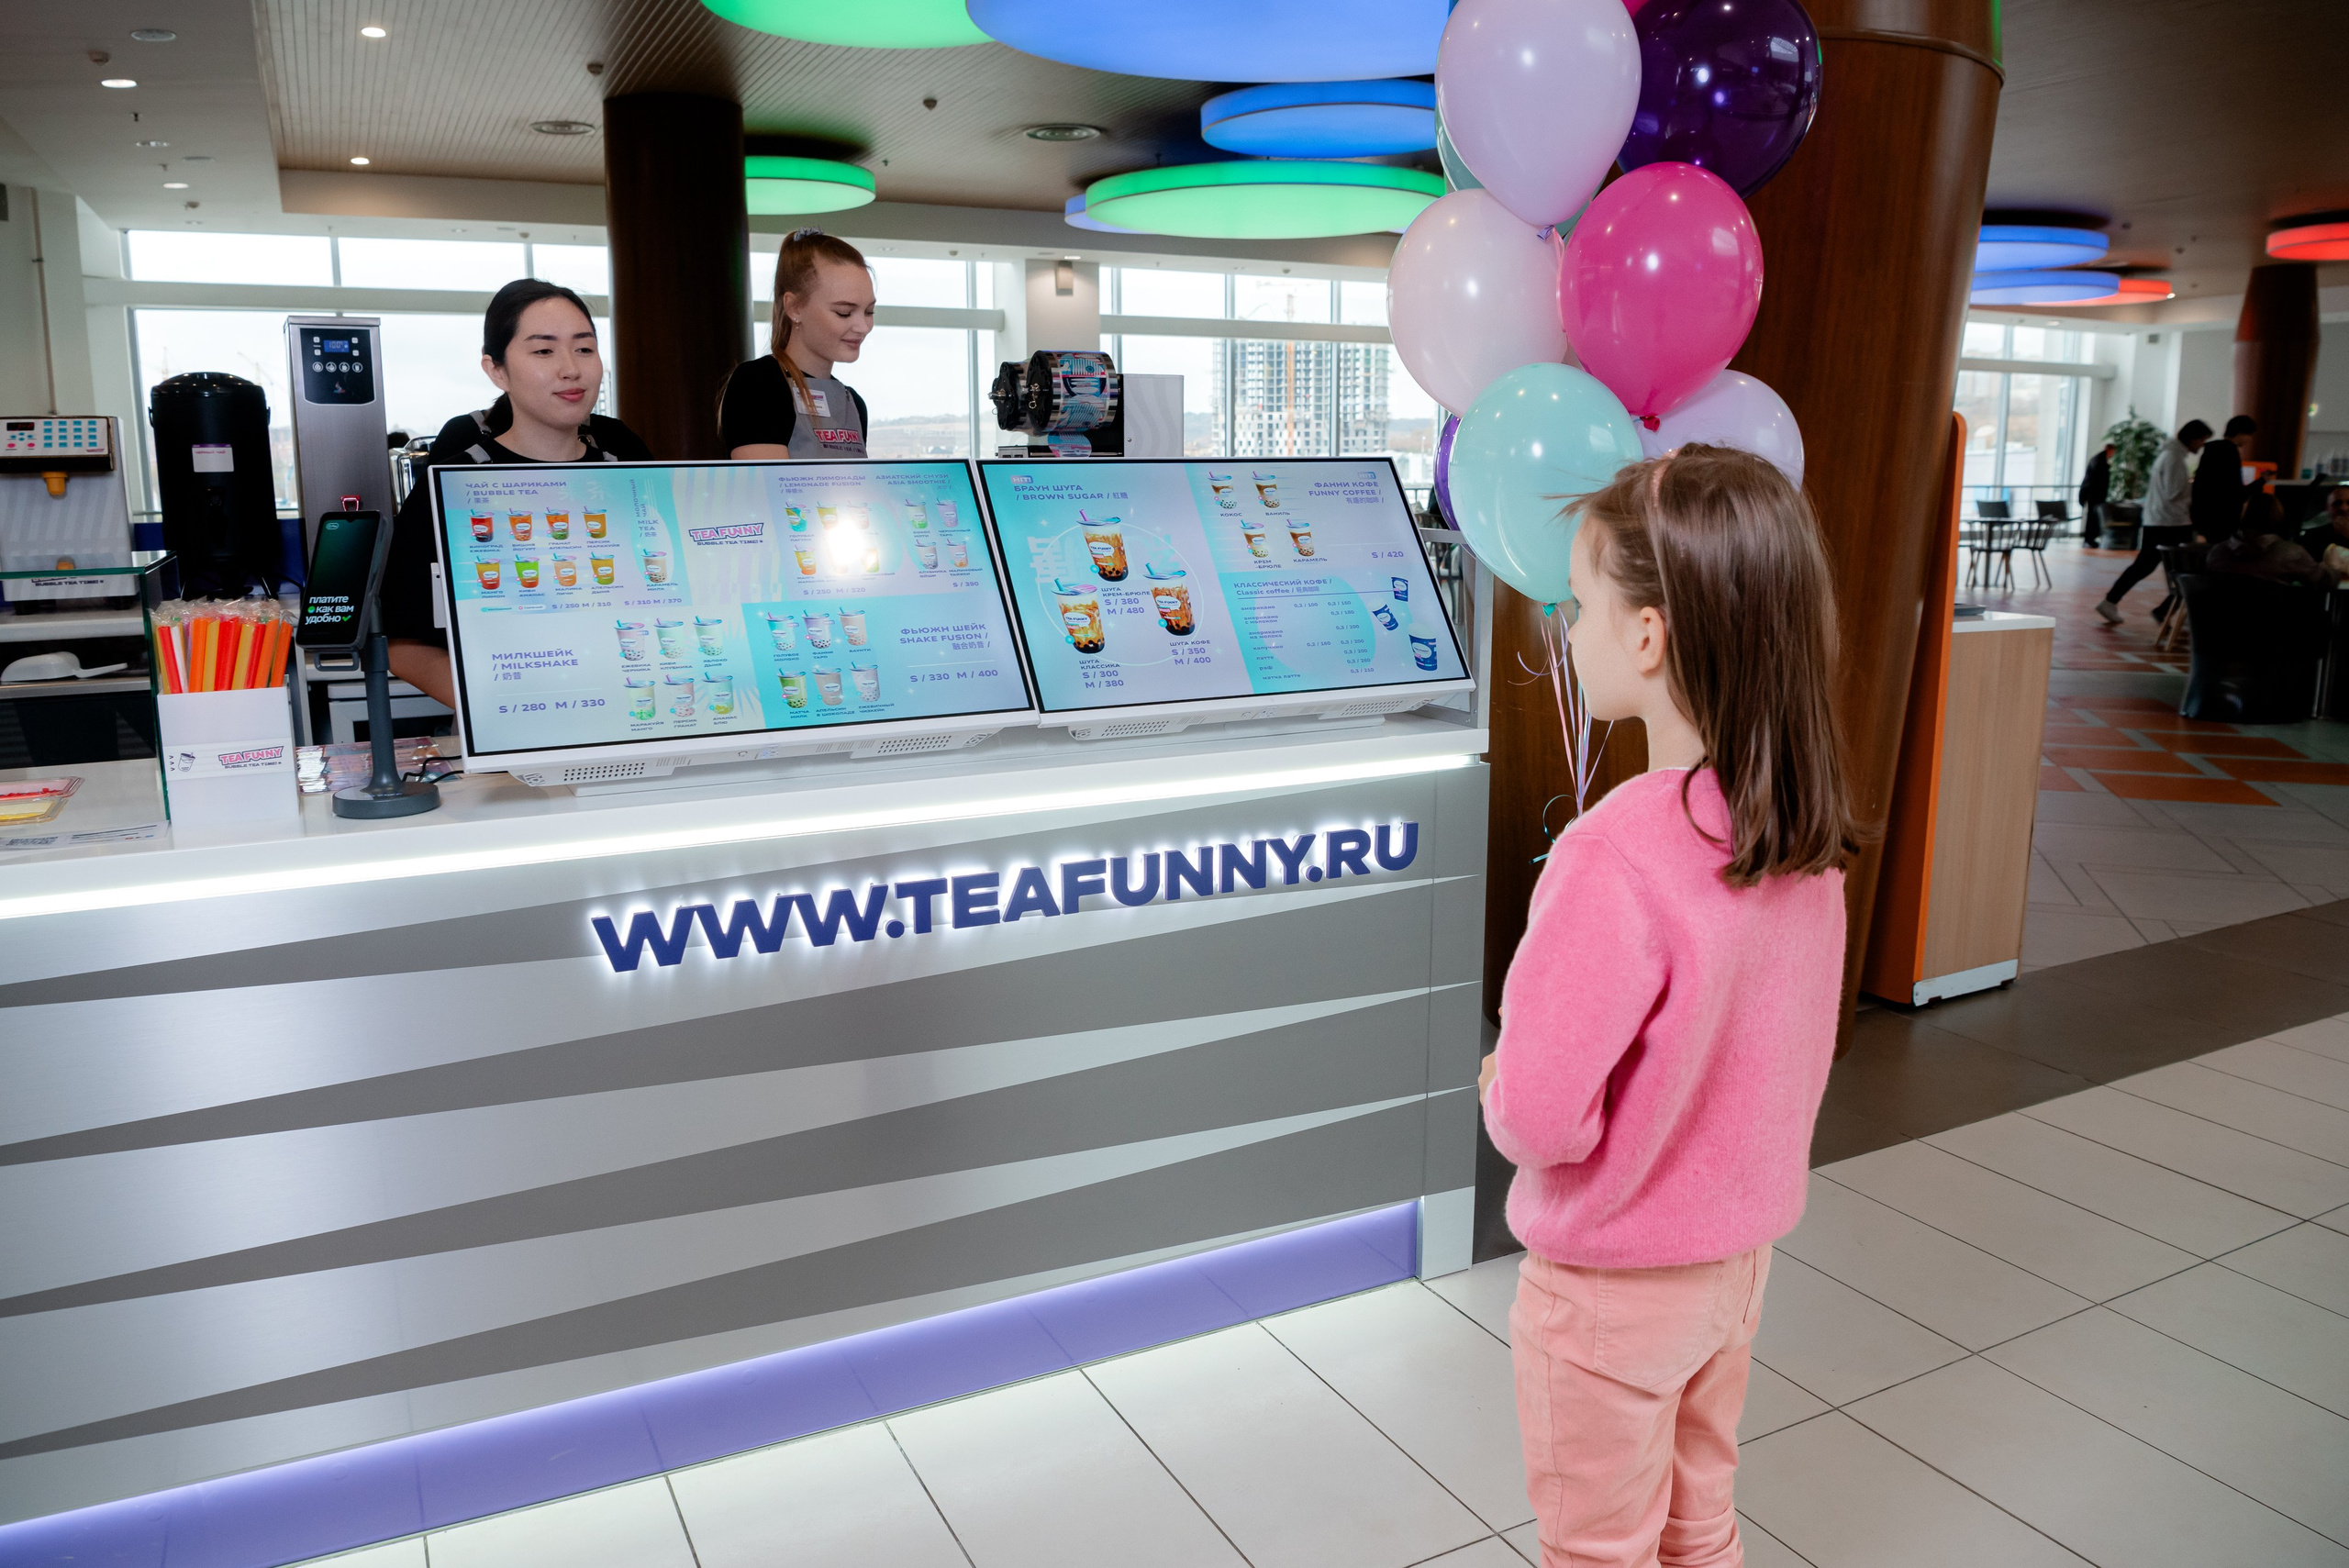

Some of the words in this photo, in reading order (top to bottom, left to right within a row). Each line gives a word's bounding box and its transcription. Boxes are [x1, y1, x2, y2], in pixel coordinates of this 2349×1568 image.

[815, 430, 837, 441] TEA
[691, 528, 717, 540] TEA
[717, 524, 762, 539] FUNNY
[1233, 579, 1302, 588] КЛАССИЧЕСКИЙ
[308, 595, 349, 604] платите
[305, 613, 341, 625] удобно
[901, 626, 950, 635] ФЬЮЖН
[952, 622, 986, 632] ШЕЙК
[900, 636, 938, 644] SHAKE
[941, 633, 982, 641] FUSION
[492, 649, 573, 661] МИЛКШЕЙК
[1193, 656, 1211, 664] 400
[501, 659, 579, 670] MILKSHAKE
[929, 673, 950, 682] 330
[978, 669, 998, 677] 400
[1099, 670, 1119, 678] 300
[499, 706, 508, 714] S
[521, 703, 547, 712] 280
[555, 701, 568, 709] M
[581, 698, 606, 707] 330
[220, 754, 243, 764] TEA
[243, 749, 281, 761] FUNNY
[591, 820, 1419, 973] WWW.TEAFUNNY.RU
